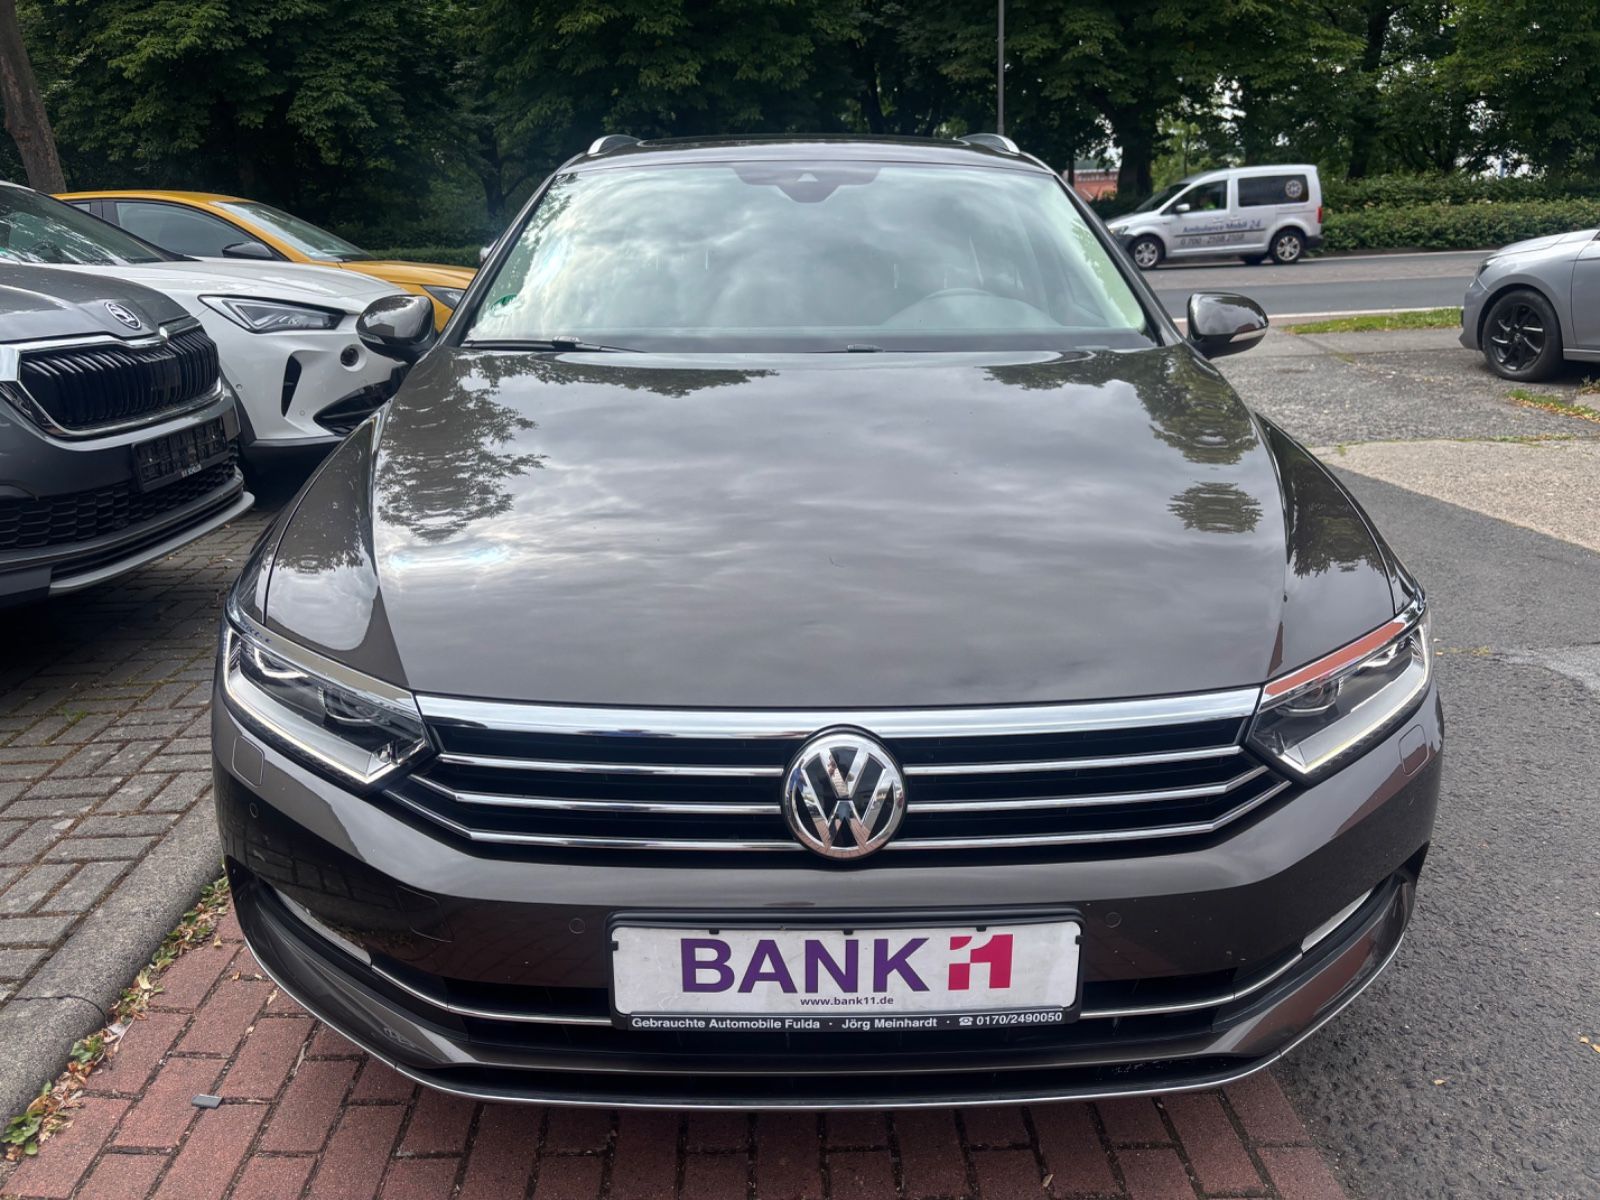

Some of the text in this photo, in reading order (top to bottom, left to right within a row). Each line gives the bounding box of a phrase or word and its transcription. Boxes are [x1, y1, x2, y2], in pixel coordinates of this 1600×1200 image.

[800, 996, 894, 1006] www.bank11.de
[631, 1012, 1063, 1031] Gebrauchte Automobile Fulda Jörg Meinhardt 0170/2490050
